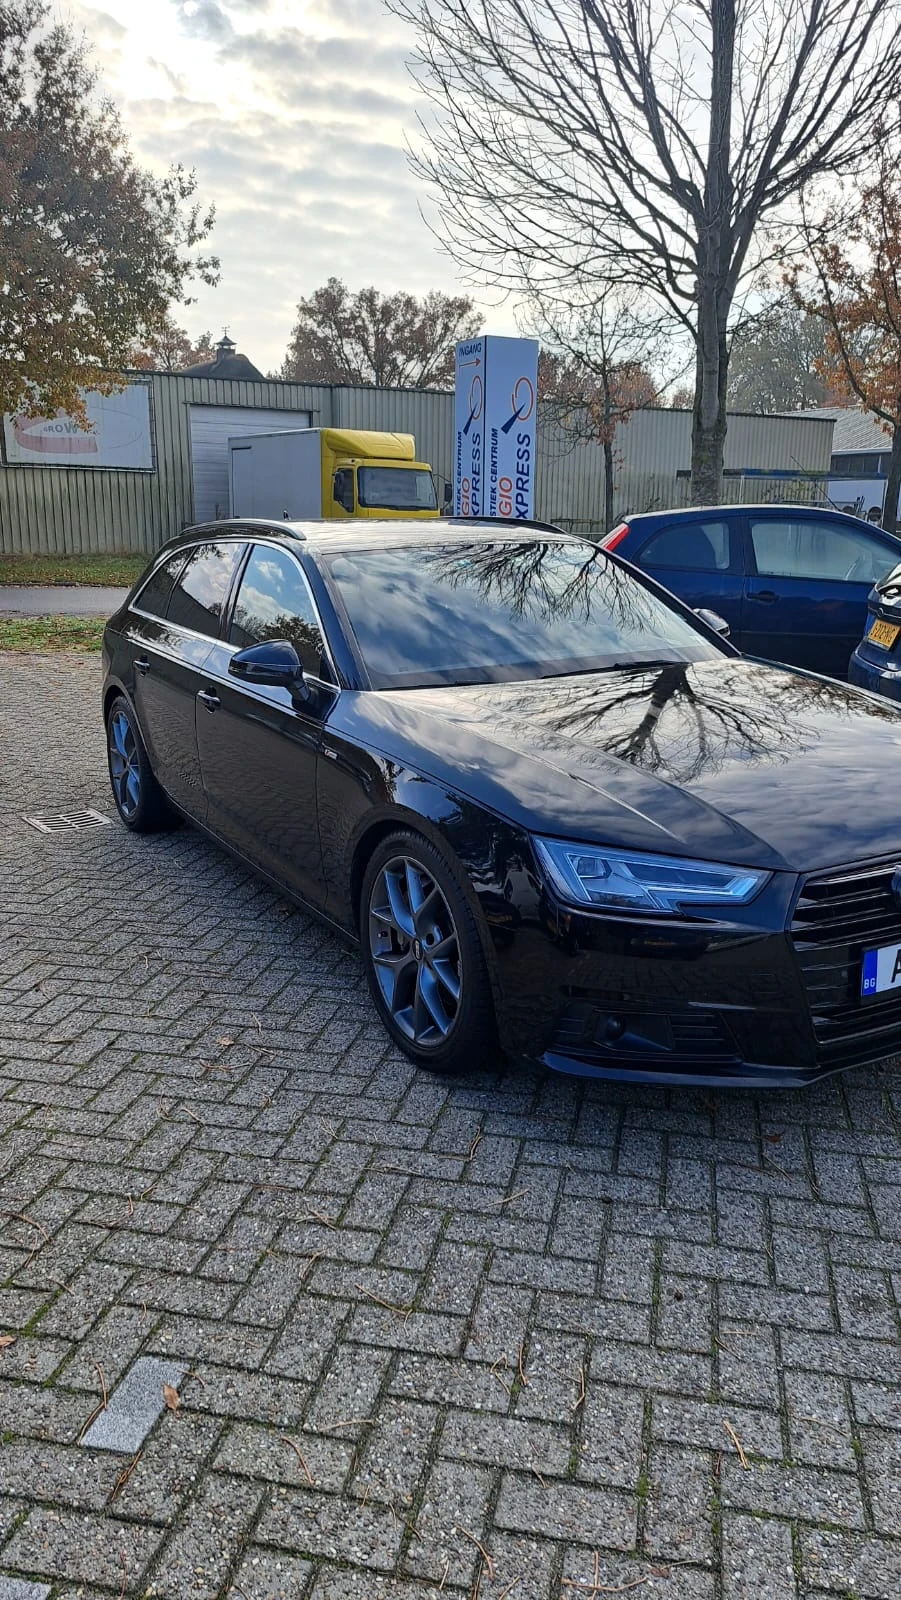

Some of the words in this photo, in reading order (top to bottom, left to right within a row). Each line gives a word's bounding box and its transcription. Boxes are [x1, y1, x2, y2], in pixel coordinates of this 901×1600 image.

[459, 342, 481, 356] INGANG
[490, 427, 499, 483] CENTRUM
[498, 477, 513, 516] GIO
[864, 978, 876, 989] BG
